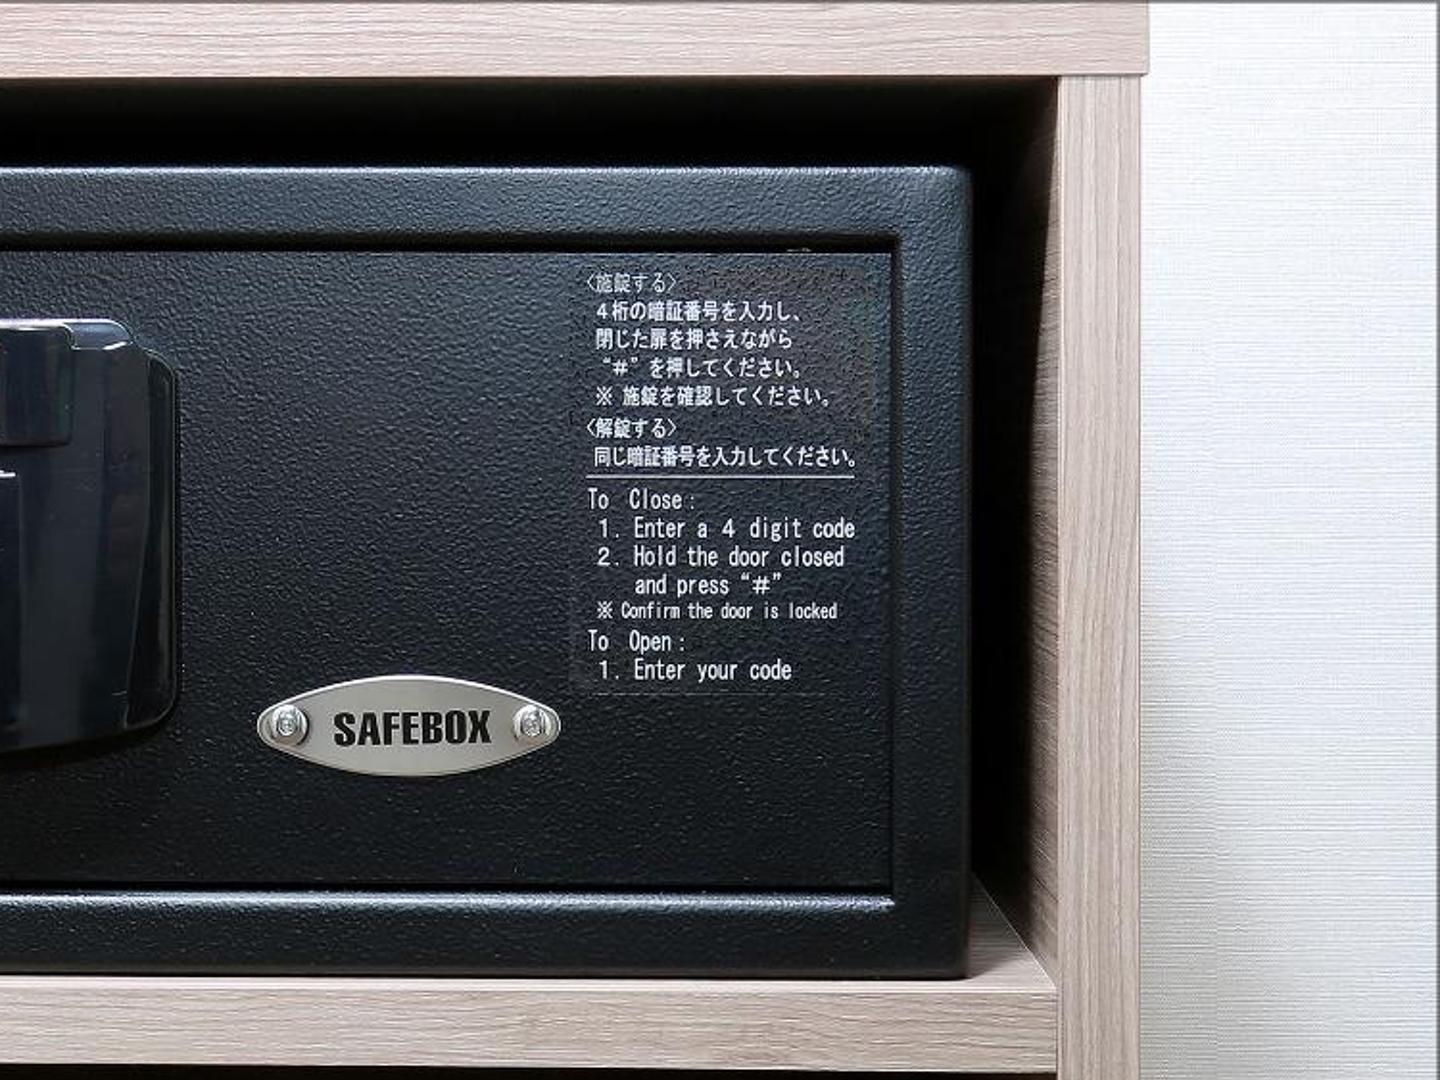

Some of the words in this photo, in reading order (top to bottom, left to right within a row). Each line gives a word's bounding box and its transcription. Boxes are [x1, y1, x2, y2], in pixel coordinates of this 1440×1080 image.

[595, 328, 793, 351] 閉じた扉を押さえながら
[594, 446, 856, 468] 同じ暗証番号を入力してください。
[587, 487, 609, 510] To
[598, 517, 620, 539] 1.
[634, 516, 686, 539] Enter
[697, 522, 708, 539] a
[721, 517, 736, 539] 4
[749, 517, 802, 543] digit
[812, 517, 855, 539] code
[597, 547, 620, 567] 2.
[633, 544, 677, 567] Hold
[688, 545, 719, 567] the
[728, 545, 769, 567] door
[781, 545, 844, 567] closed
[635, 573, 667, 595] and
[677, 576, 730, 598] press
[621, 600, 681, 620] Confirm
[688, 601, 714, 620] the
[720, 601, 753, 620] door
[764, 602, 779, 620] is
[789, 601, 838, 620] locked
[587, 629, 609, 651] To
[598, 659, 620, 680] 1.
[634, 658, 686, 680] Enter
[697, 662, 738, 683] your
[749, 658, 792, 680] code
[333, 709, 491, 747] SAFEBOX
